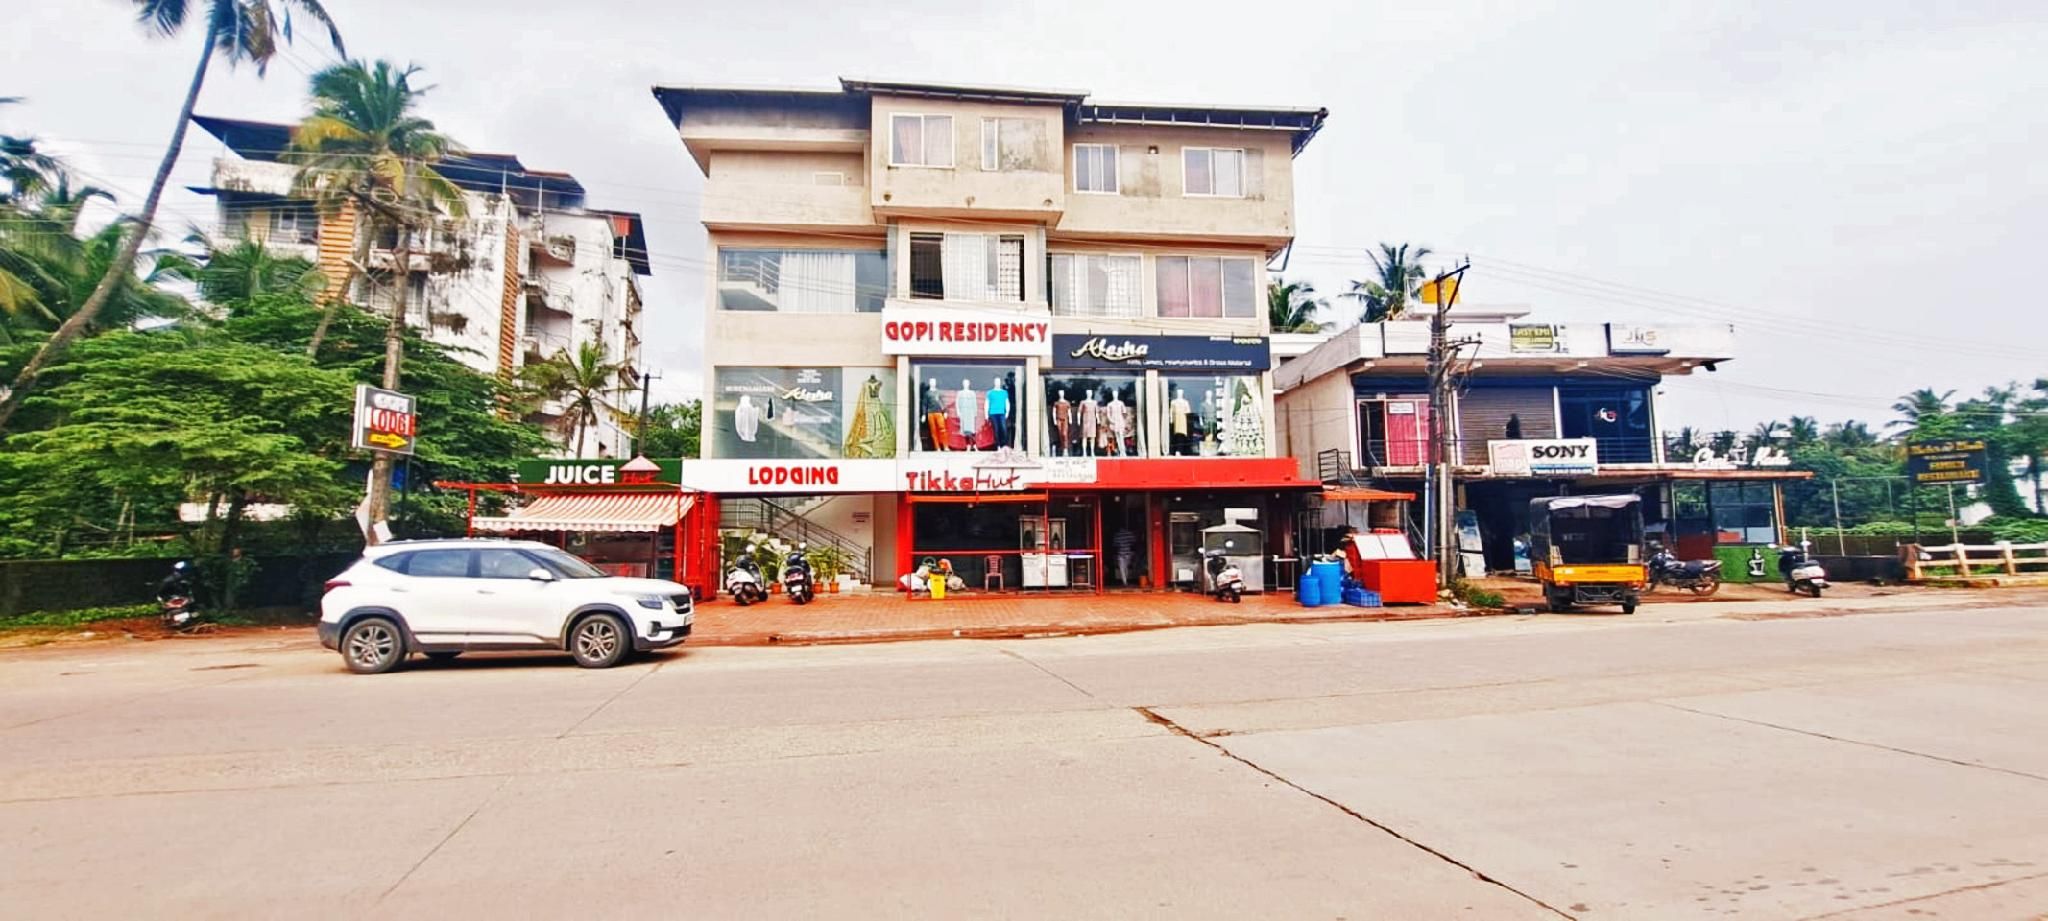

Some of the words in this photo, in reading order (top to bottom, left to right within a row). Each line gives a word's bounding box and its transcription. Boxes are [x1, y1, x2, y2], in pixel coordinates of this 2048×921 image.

[885, 321, 933, 341] GOPI
[939, 322, 1048, 342] RESIDENCY
[1531, 445, 1590, 459] SONY
[544, 465, 615, 484] JUICE
[749, 466, 838, 484] LODGING
[906, 470, 974, 491] Tikka
[976, 467, 1020, 489] Hut
